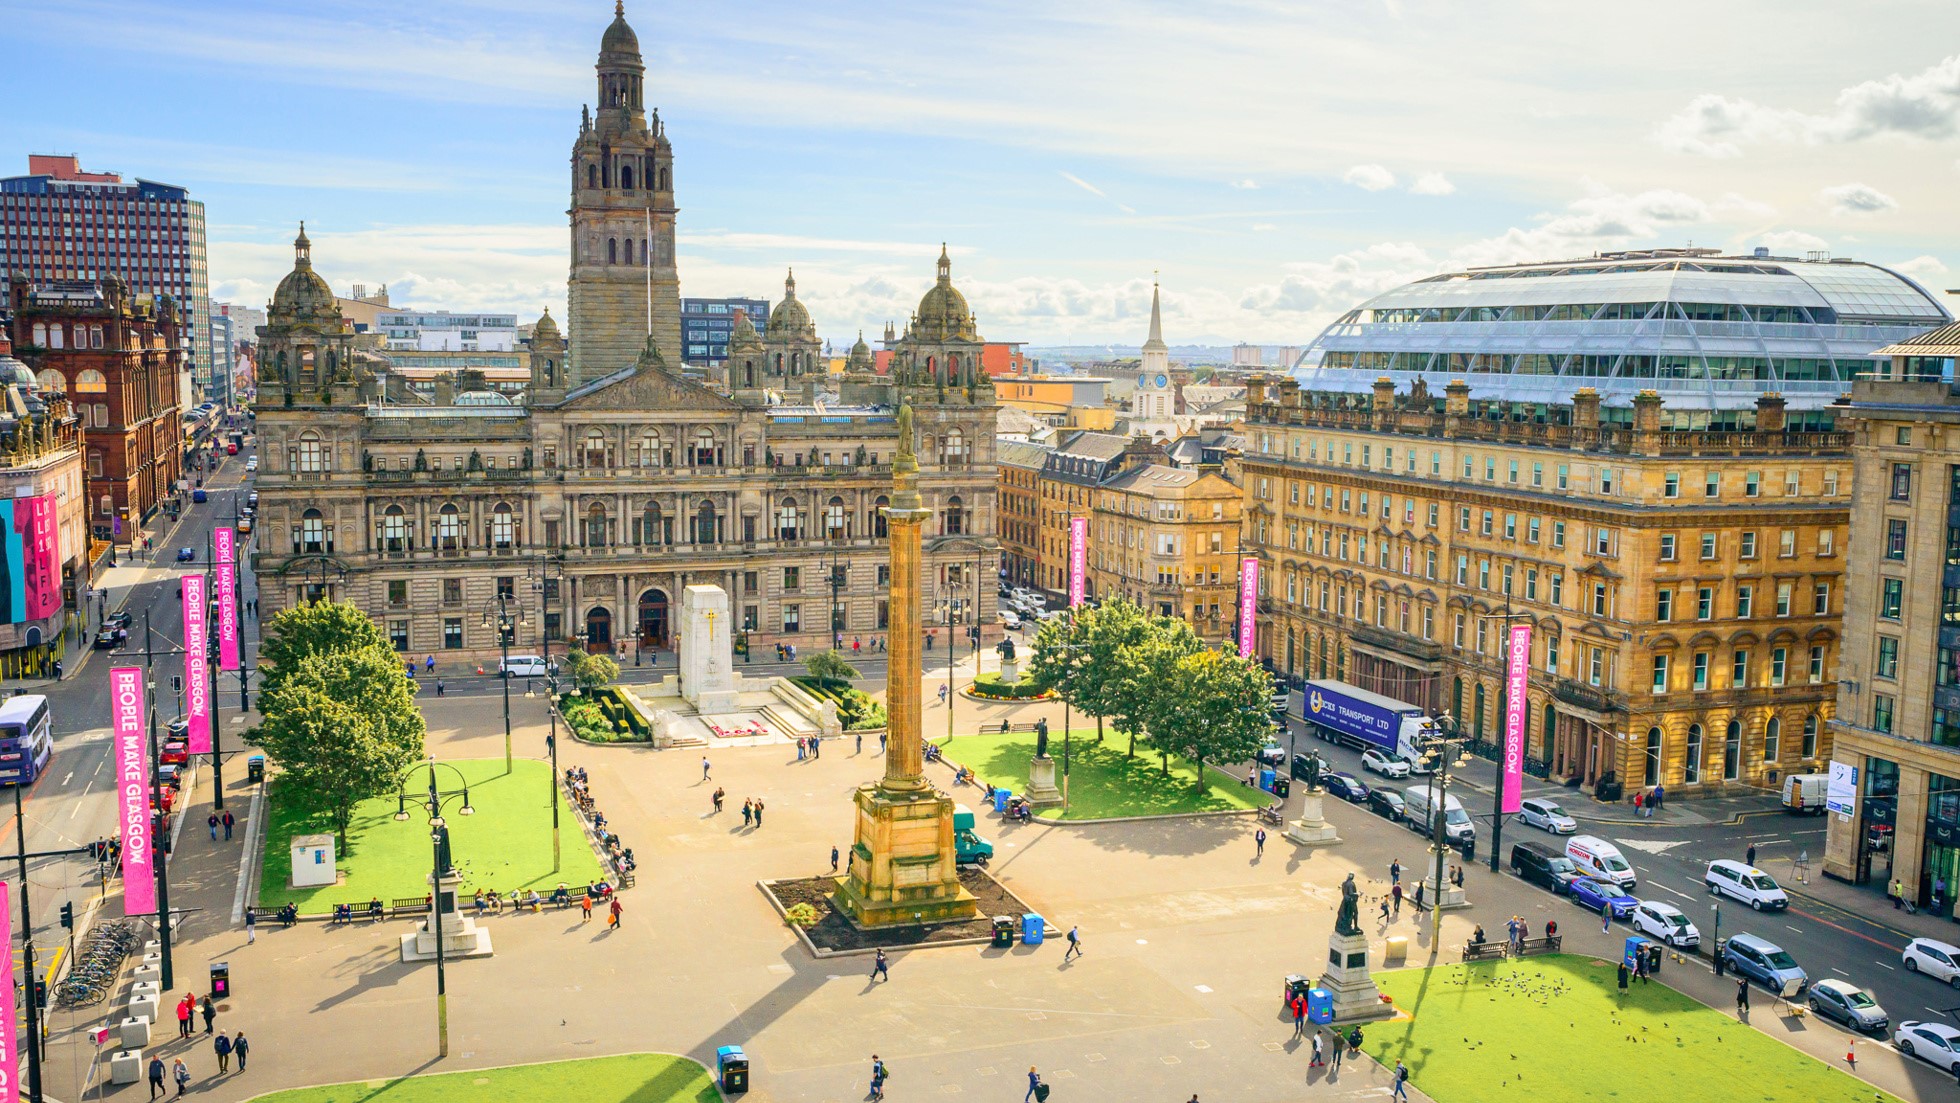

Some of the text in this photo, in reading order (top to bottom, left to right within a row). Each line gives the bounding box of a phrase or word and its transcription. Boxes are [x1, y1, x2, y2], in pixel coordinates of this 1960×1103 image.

[220, 532, 233, 641] PEOPLE MAKE GLASGOW
[1243, 599, 1252, 625] MAKE
[1245, 562, 1254, 597] PEOPLE
[187, 579, 204, 716] PEOPLE MAKE GLASGOW
[1338, 706, 1374, 725] TRANSPORT
[1376, 719, 1389, 730] LTD
[1508, 631, 1525, 774] PEOPLE MAKE GLASGOW
[118, 673, 145, 864] PEOPLE MAKE GLASGOW
[1568, 847, 1590, 860] HORIZON
